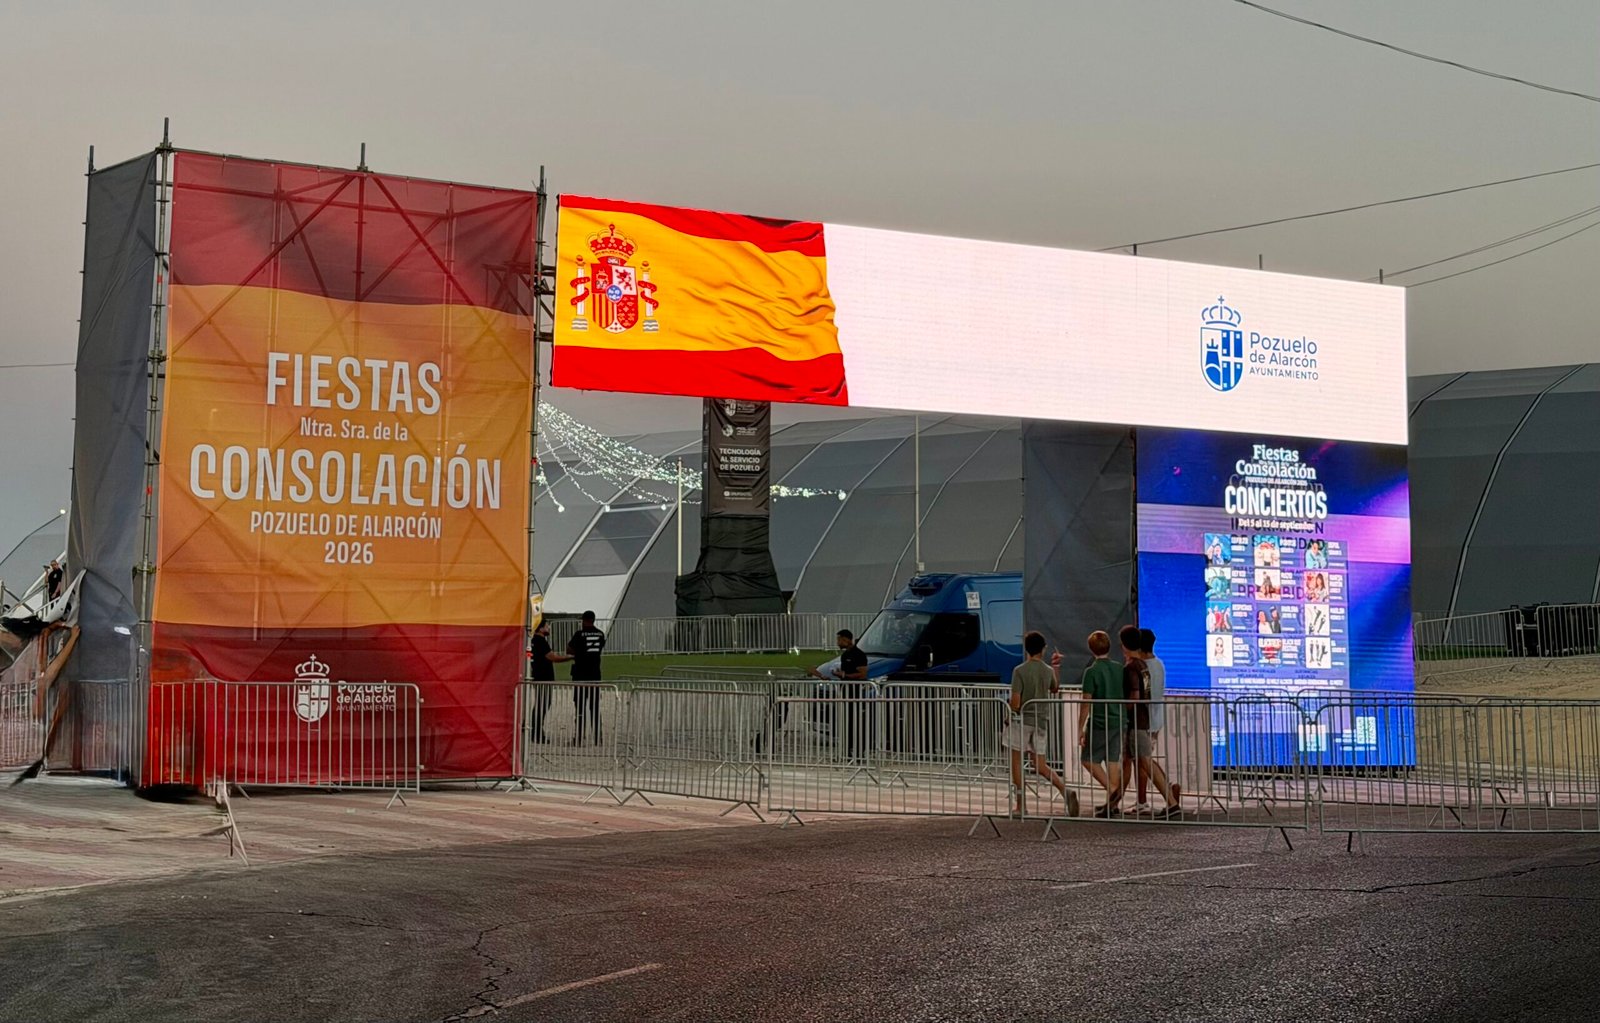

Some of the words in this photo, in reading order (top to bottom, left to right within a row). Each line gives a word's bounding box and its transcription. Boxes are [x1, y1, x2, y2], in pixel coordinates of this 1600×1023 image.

[1250, 332, 1318, 355] Pozuelo
[1249, 350, 1266, 364] de
[1269, 352, 1317, 369] Alarcón
[266, 351, 442, 415] FIESTAS
[1249, 366, 1319, 381] AYUNTAMIENTO
[300, 416, 337, 438] Ntra.
[341, 419, 370, 440] Sra.
[373, 421, 390, 441] de
[394, 422, 408, 442] la
[719, 448, 762, 456] TECNOLOGÍA
[730, 456, 760, 464] SERVICIO
[1252, 444, 1299, 462] Fiestas
[189, 443, 501, 510] CONSOLACIÓN
[730, 464, 760, 472] POZUELO
[1235, 459, 1317, 480] Consolación
[1224, 485, 1328, 519] CONCIERTOS
[250, 510, 330, 536] POZUELO
[335, 514, 358, 537] DE
[361, 511, 442, 539] ALARCÓN
[1238, 518, 1250, 527] Del
[1250, 519, 1255, 527] 5
[1255, 519, 1262, 528] al
[324, 541, 374, 564] 2026
[337, 680, 396, 693] Pozuelo
[336, 693, 351, 704] de
[353, 691, 396, 704] Alarcón
